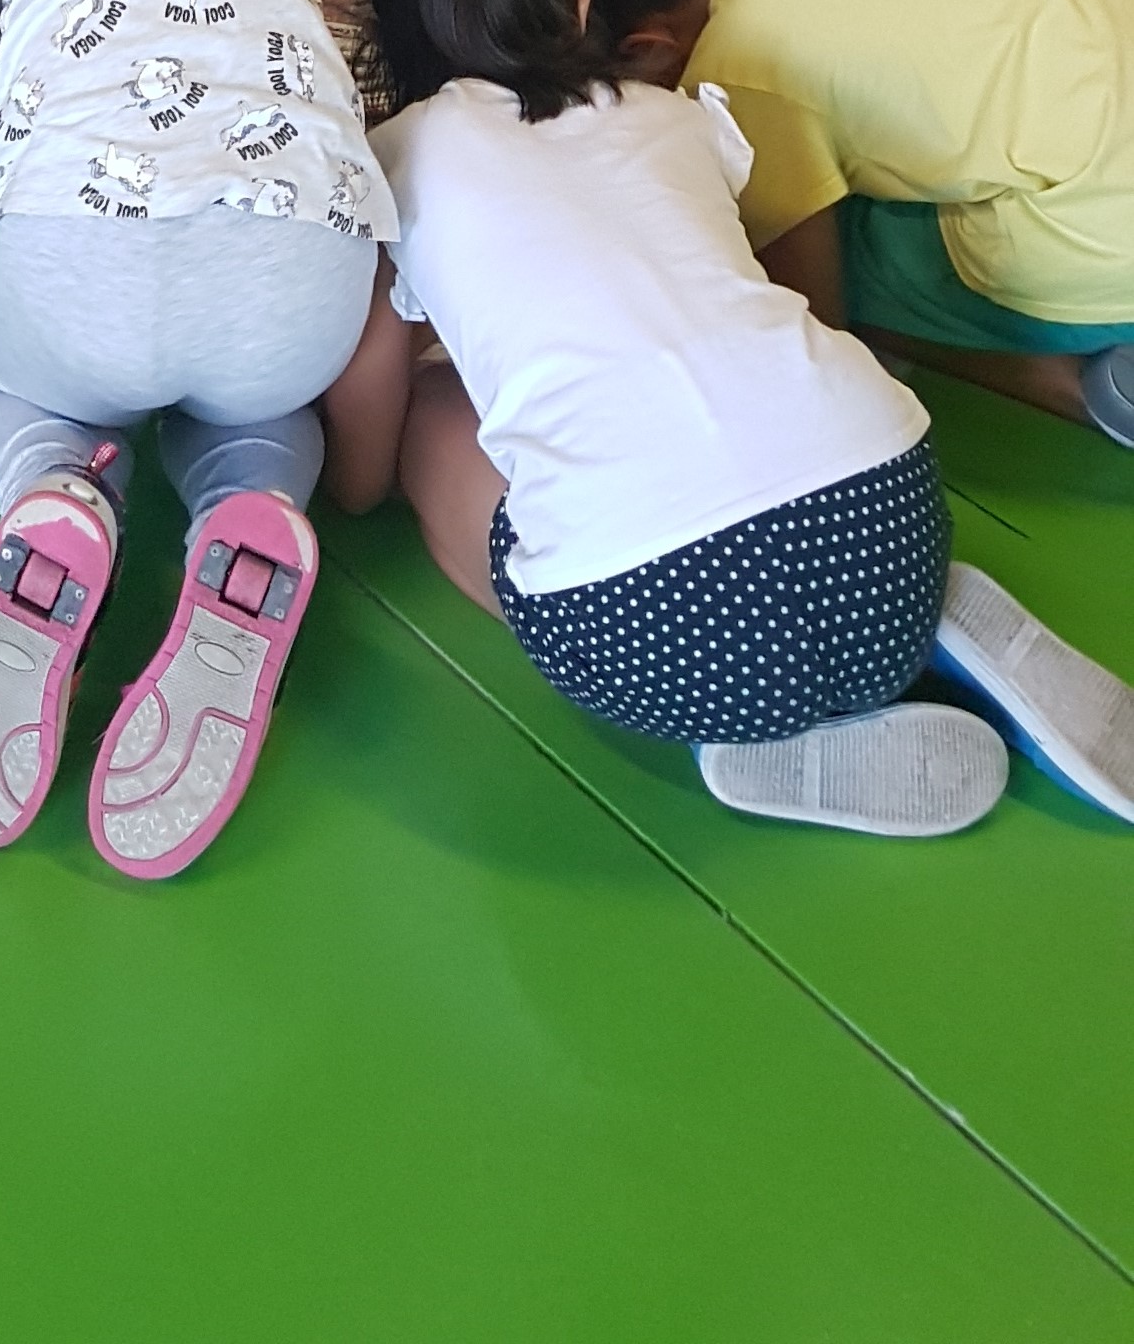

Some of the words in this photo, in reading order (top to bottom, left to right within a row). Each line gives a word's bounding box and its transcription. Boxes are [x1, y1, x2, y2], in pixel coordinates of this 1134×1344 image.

[100, 0, 127, 32] COOL
[164, 2, 198, 25] YOGA
[205, 2, 236, 25] COOL
[70, 30, 105, 59] YOGA
[266, 31, 284, 62] YOGA
[181, 81, 208, 110] COOL
[268, 66, 292, 97] COOL
[148, 105, 186, 132] YOGA
[236, 140, 271, 162] YOGA
[270, 122, 299, 152] COOL
[78, 182, 110, 216] YOGA
